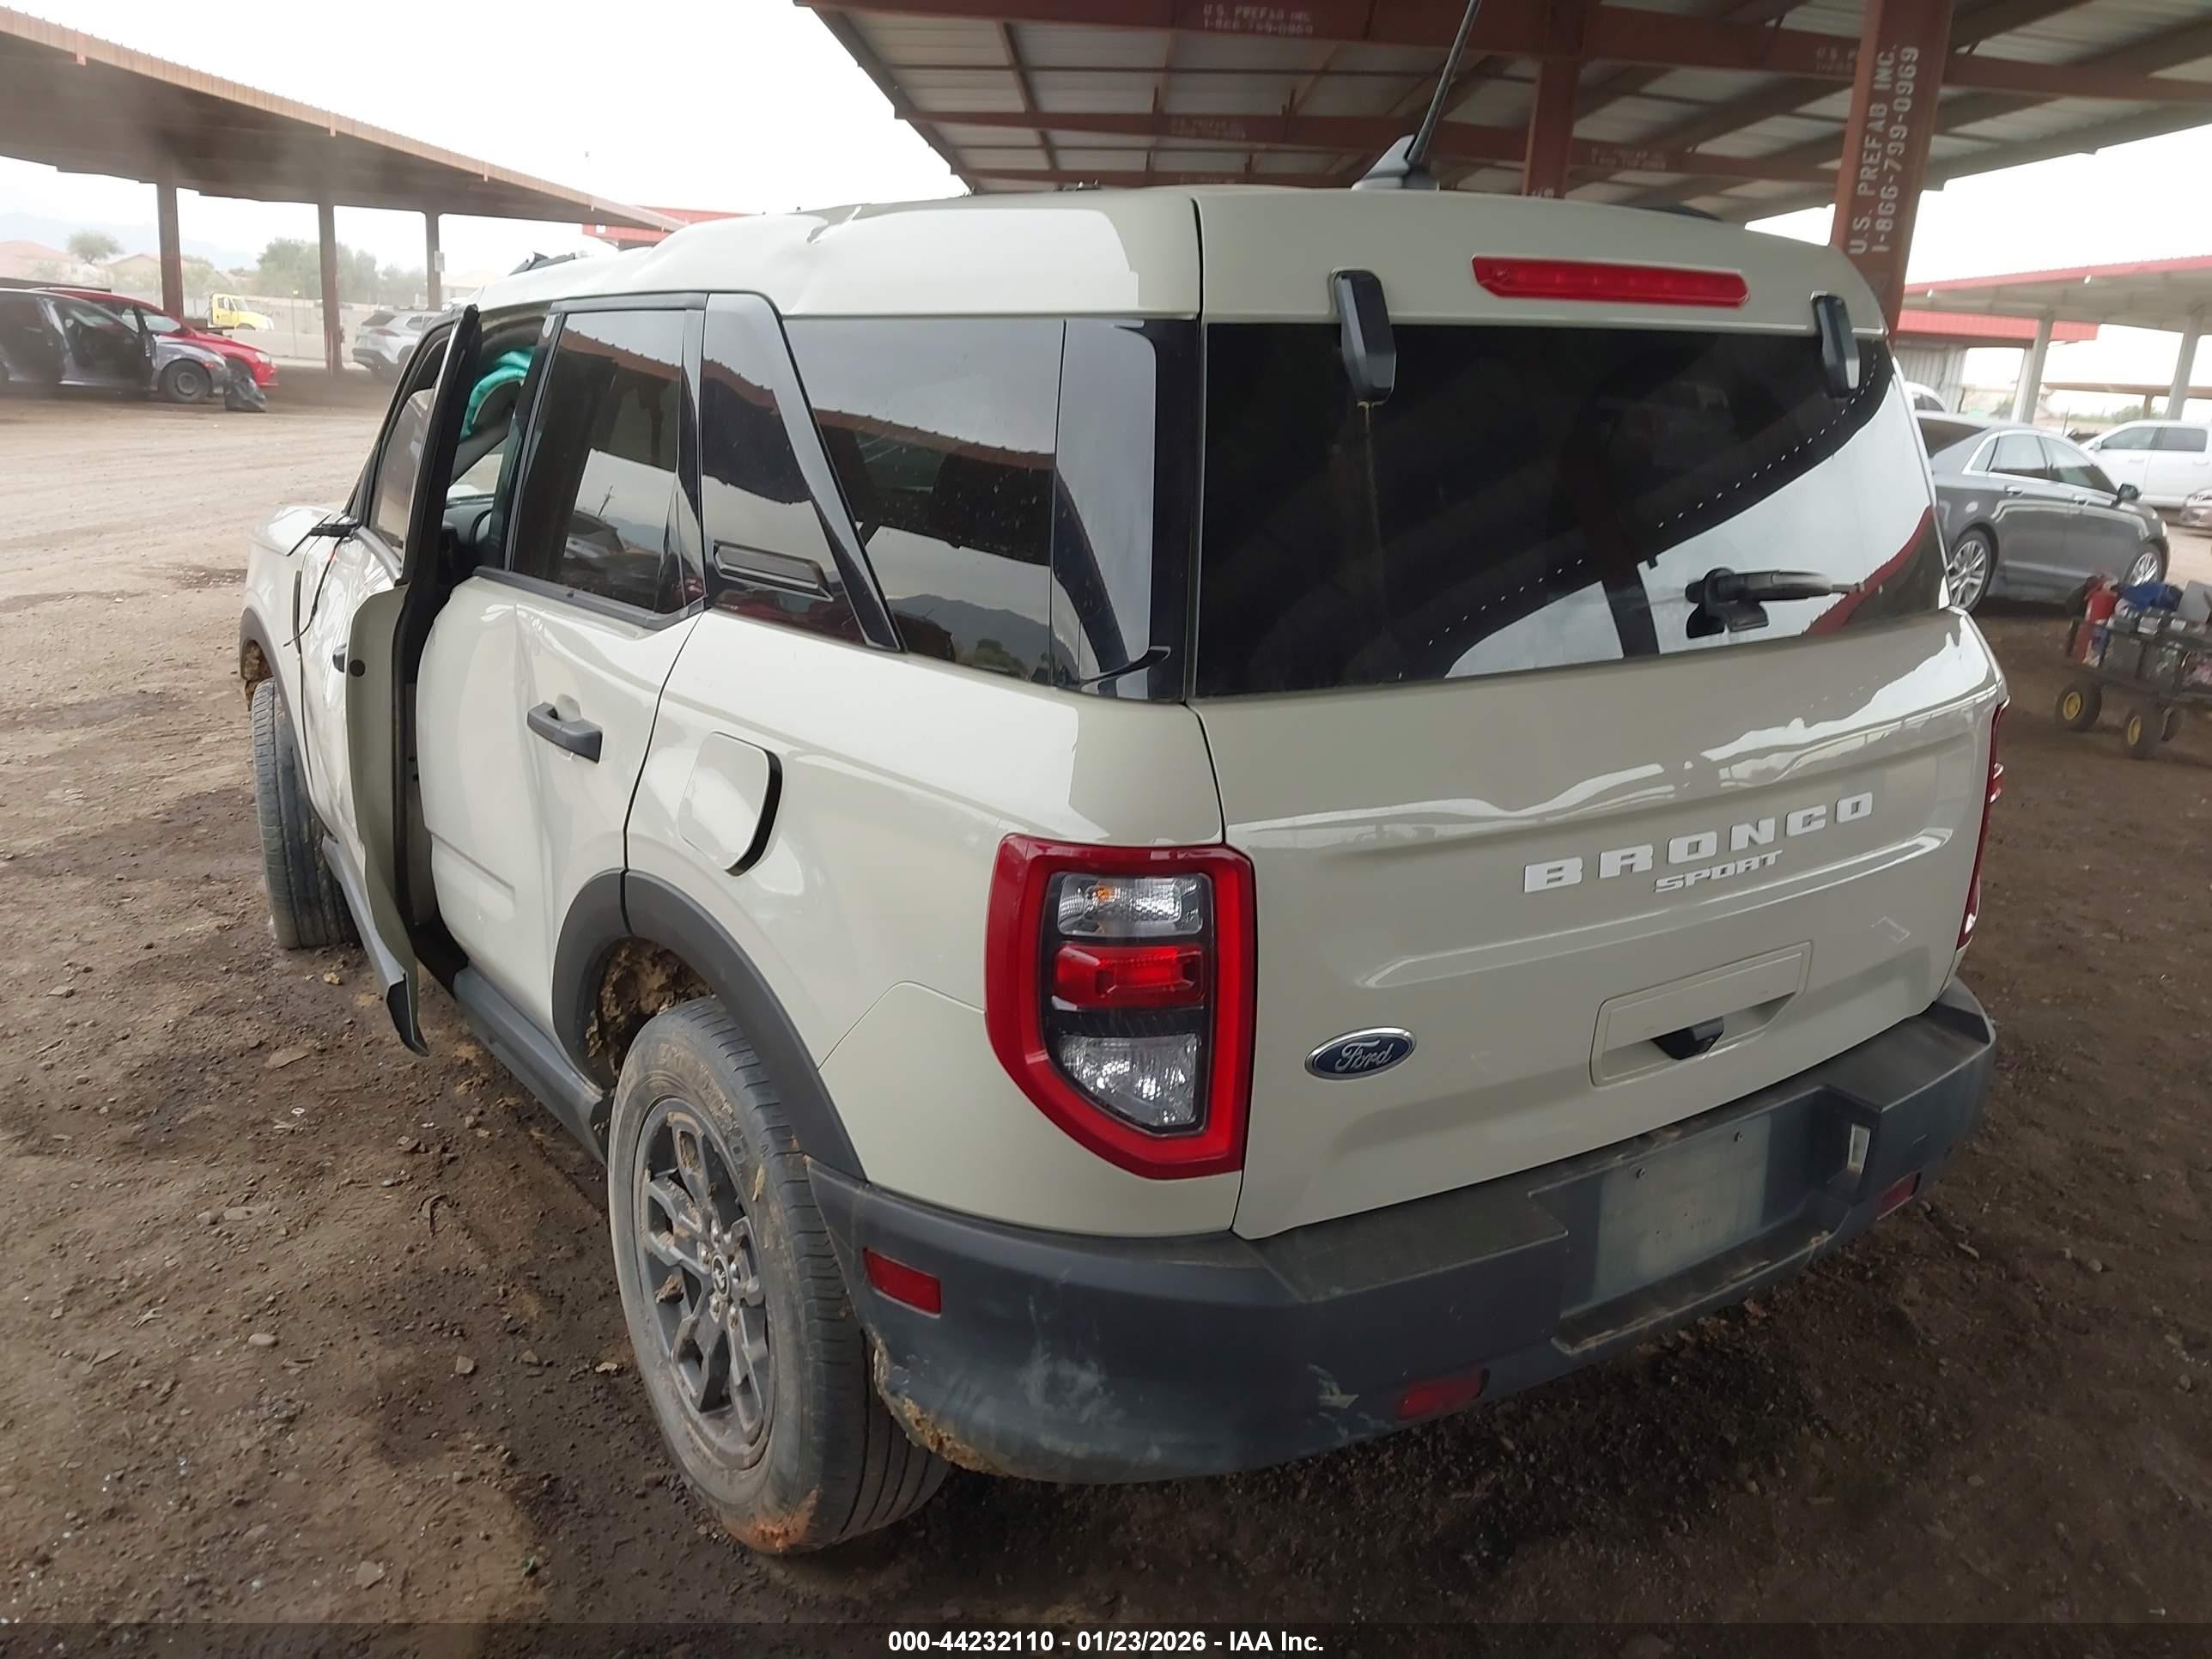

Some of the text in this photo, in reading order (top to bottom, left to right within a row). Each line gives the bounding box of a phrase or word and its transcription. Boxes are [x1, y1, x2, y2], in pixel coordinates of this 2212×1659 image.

[1849, 44, 1897, 255] U.S. PREFAB INC.
[1871, 46, 1919, 252] 1-866-799-0969
[1523, 791, 1874, 893] BRONCO
[1654, 849, 1784, 893] SPORT
[1334, 1039, 1395, 1073] Ford
